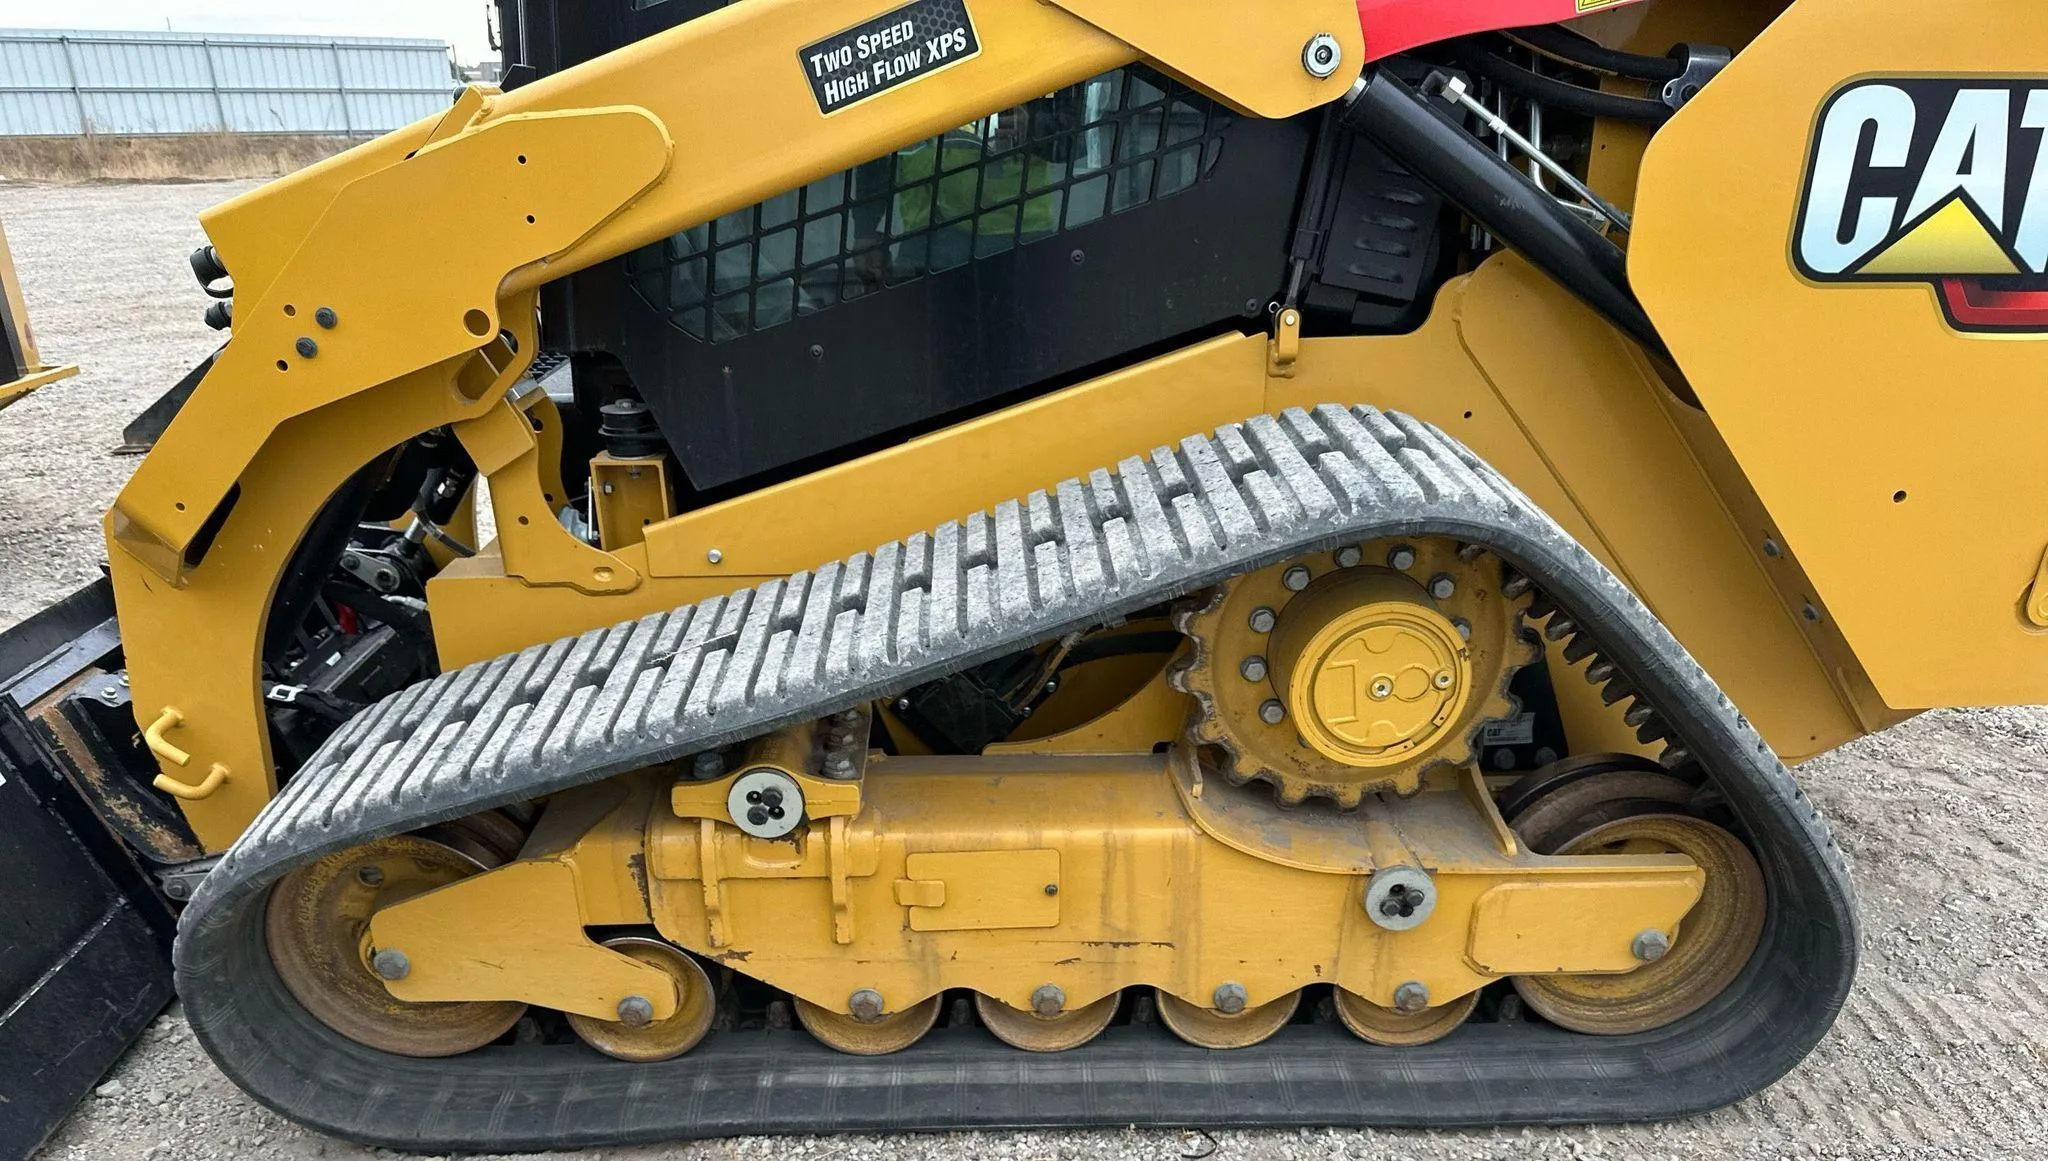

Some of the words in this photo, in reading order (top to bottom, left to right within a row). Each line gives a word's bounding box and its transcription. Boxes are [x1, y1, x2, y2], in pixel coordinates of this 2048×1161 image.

[810, 45, 852, 78] TWO
[856, 20, 914, 60] SPEED
[823, 70, 869, 106] HIGH
[872, 48, 921, 86] FLOW
[925, 27, 967, 64] XPS
